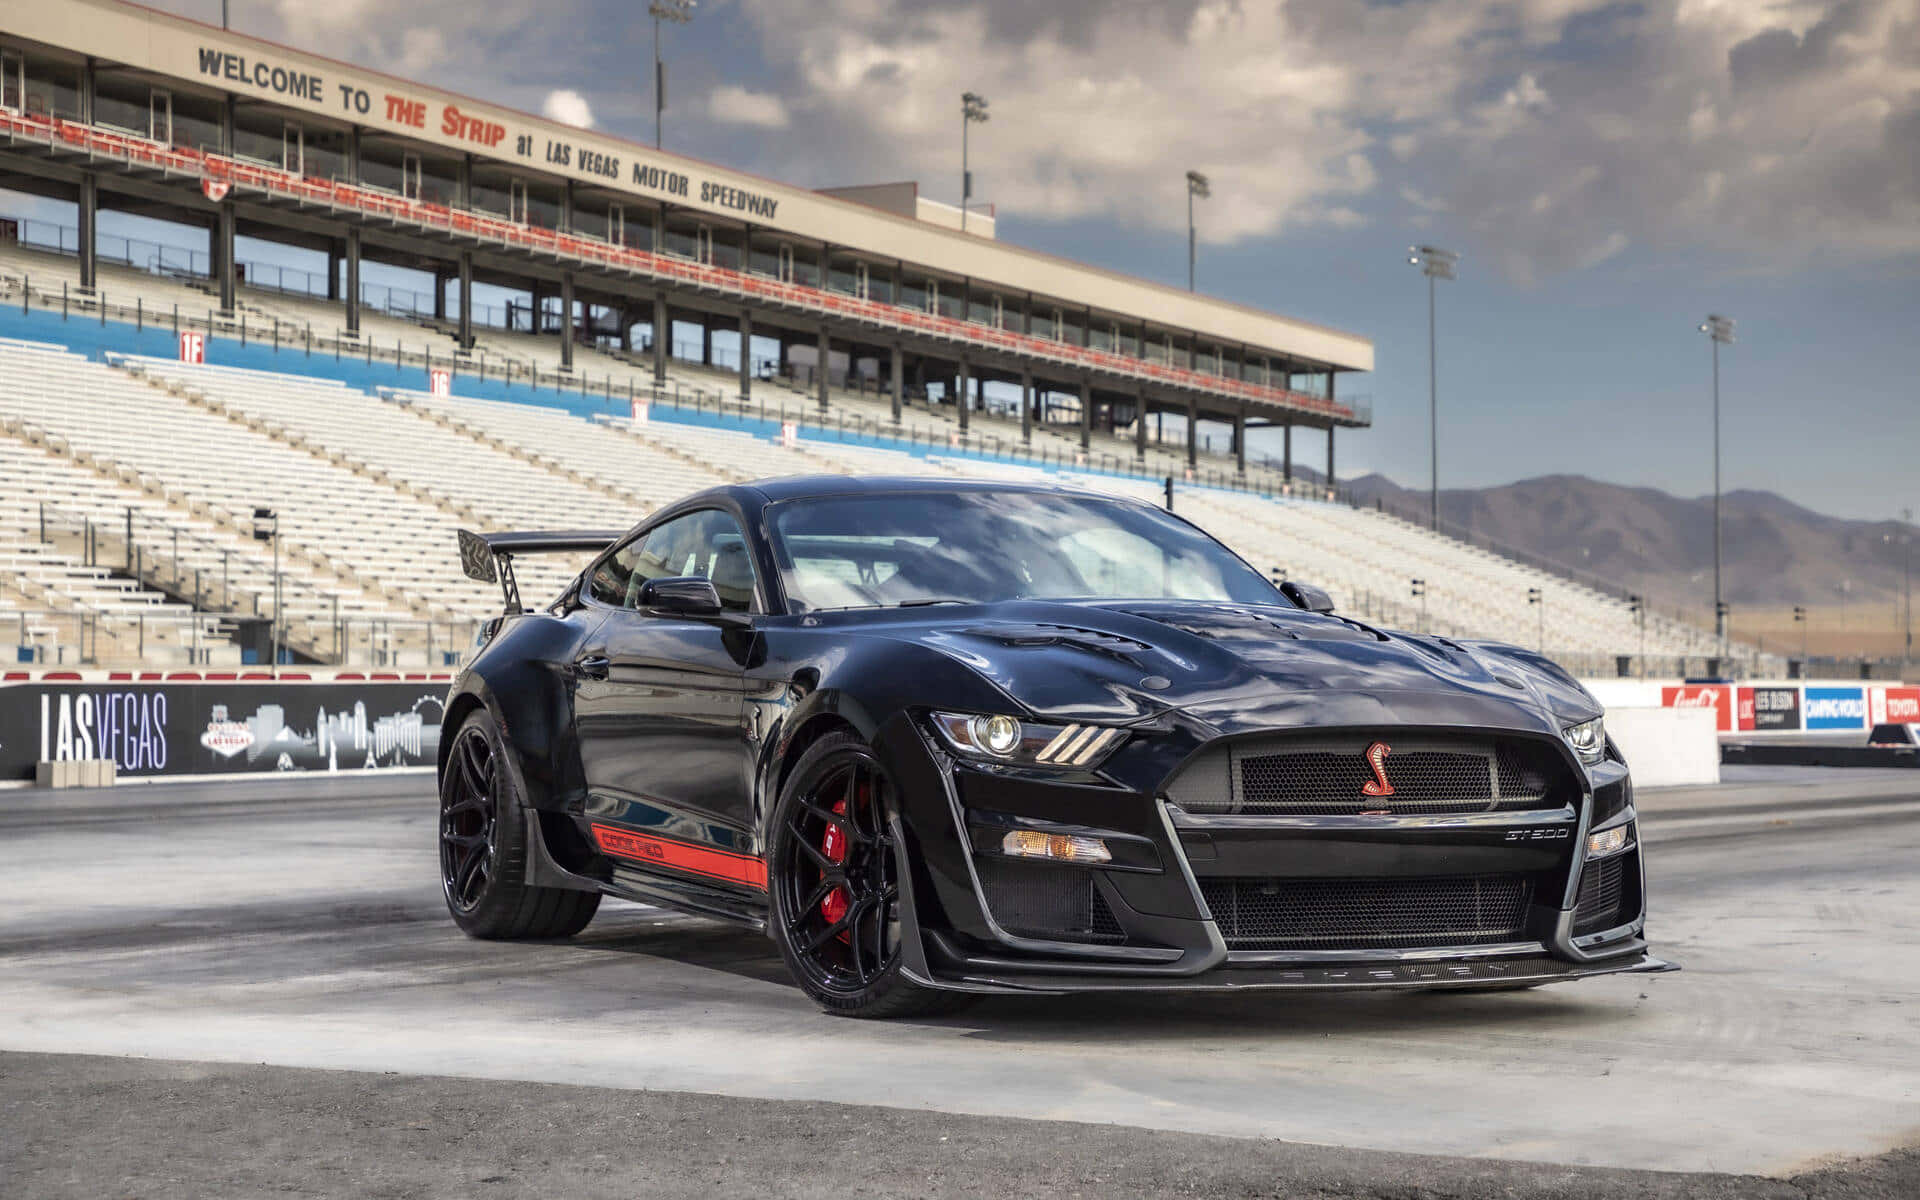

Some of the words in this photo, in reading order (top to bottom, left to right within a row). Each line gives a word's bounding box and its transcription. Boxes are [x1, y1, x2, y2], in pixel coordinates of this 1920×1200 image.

[199, 48, 323, 102] WELCOME
[339, 84, 371, 114] TO
[384, 94, 427, 129] THE
[517, 134, 533, 157] at
[546, 141, 572, 166] LAS
[578, 148, 620, 179] VEGAS
[632, 162, 689, 197] MOTOR
[701, 180, 779, 219] SPEEDWAY
[182, 334, 202, 363] 1F
